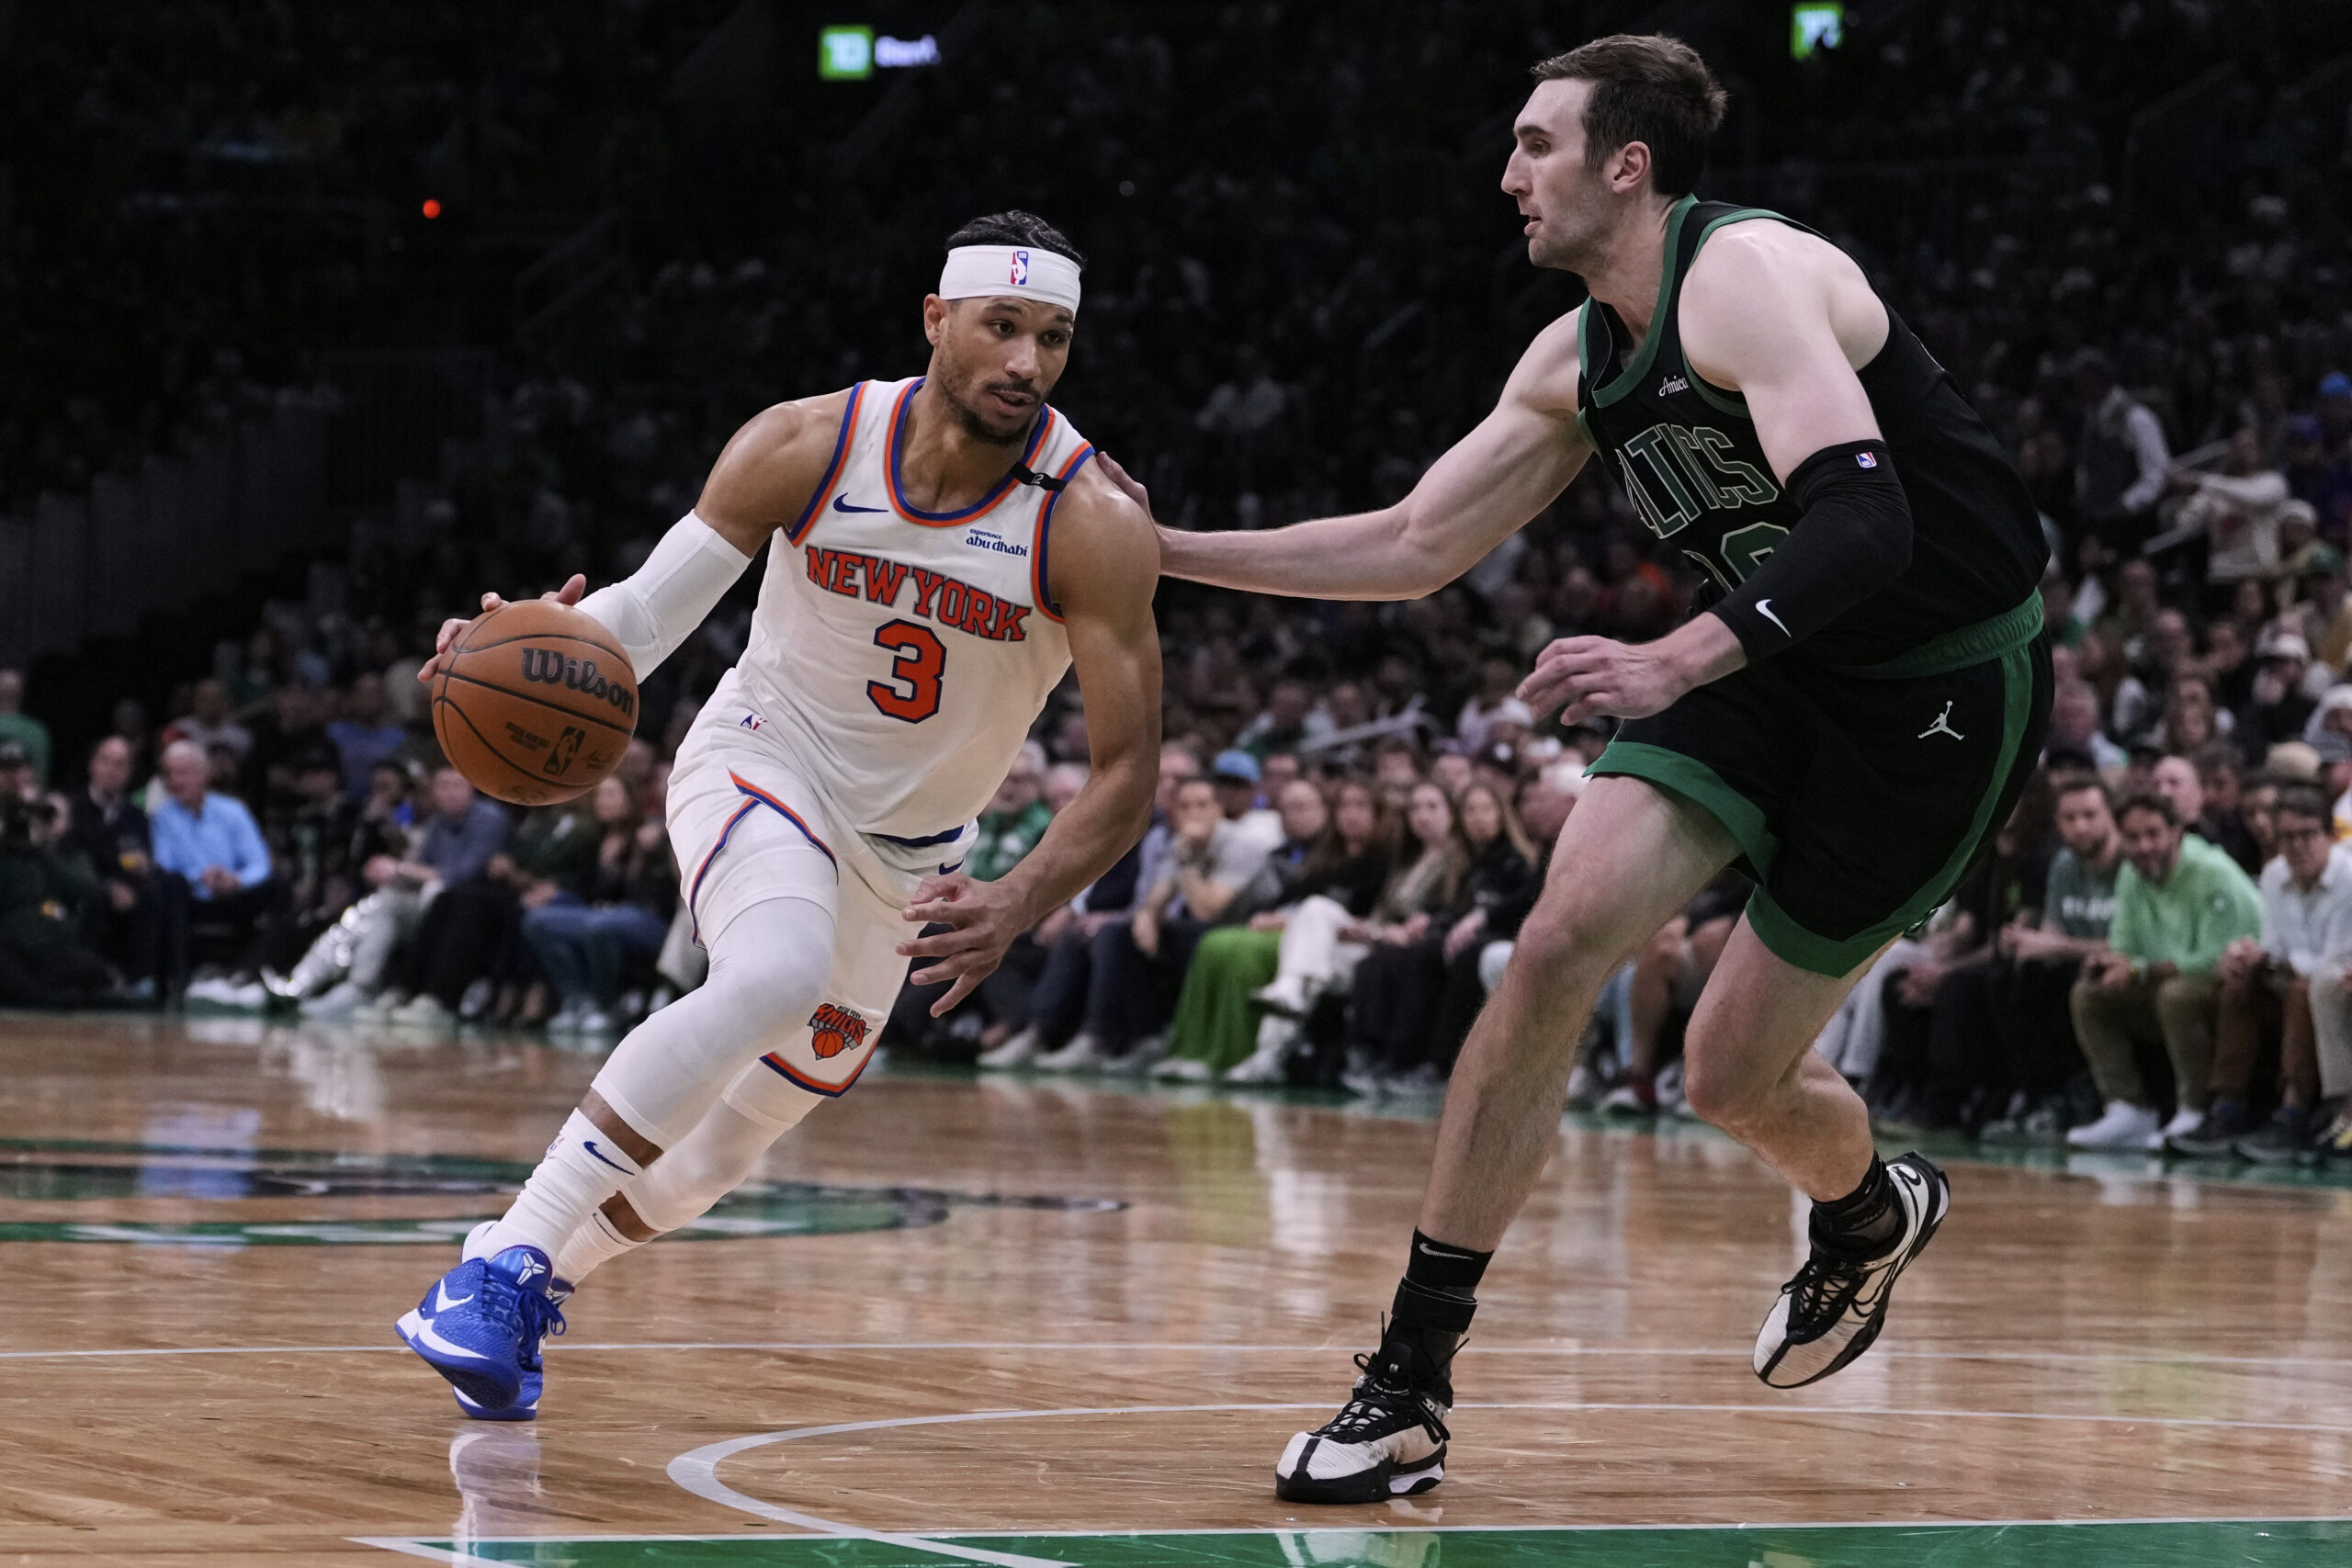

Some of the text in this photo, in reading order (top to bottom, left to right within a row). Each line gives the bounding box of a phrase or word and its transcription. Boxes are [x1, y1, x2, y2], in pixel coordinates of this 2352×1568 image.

[1658, 375, 1689, 397] Amica
[1615, 422, 1780, 539] LTICS
[966, 536, 1028, 557] abu dhabi
[969, 528, 1002, 540] experience
[805, 543, 1033, 642] NEW YORK
[521, 647, 634, 720] Wilson
[865, 618, 947, 724] 3
